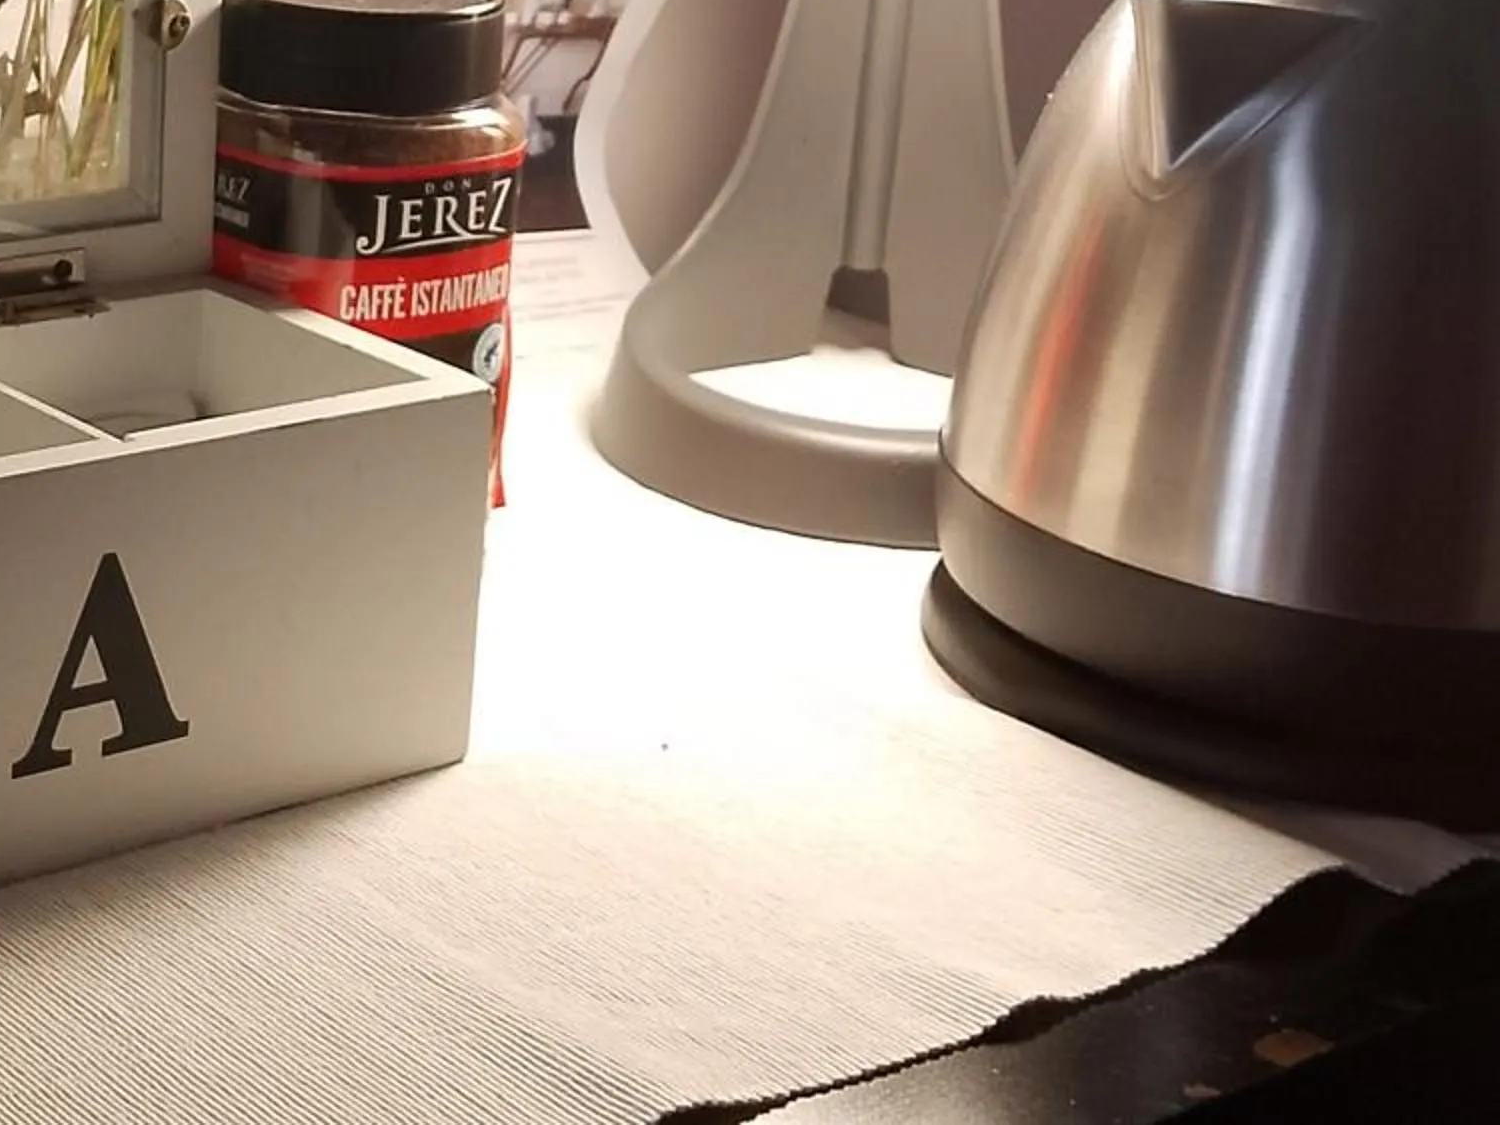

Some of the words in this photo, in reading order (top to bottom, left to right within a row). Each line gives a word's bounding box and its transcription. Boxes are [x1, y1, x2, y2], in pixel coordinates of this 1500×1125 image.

[425, 178, 472, 195] DON
[356, 177, 513, 255] JEREZ
[339, 276, 407, 321] CAFFÈ
